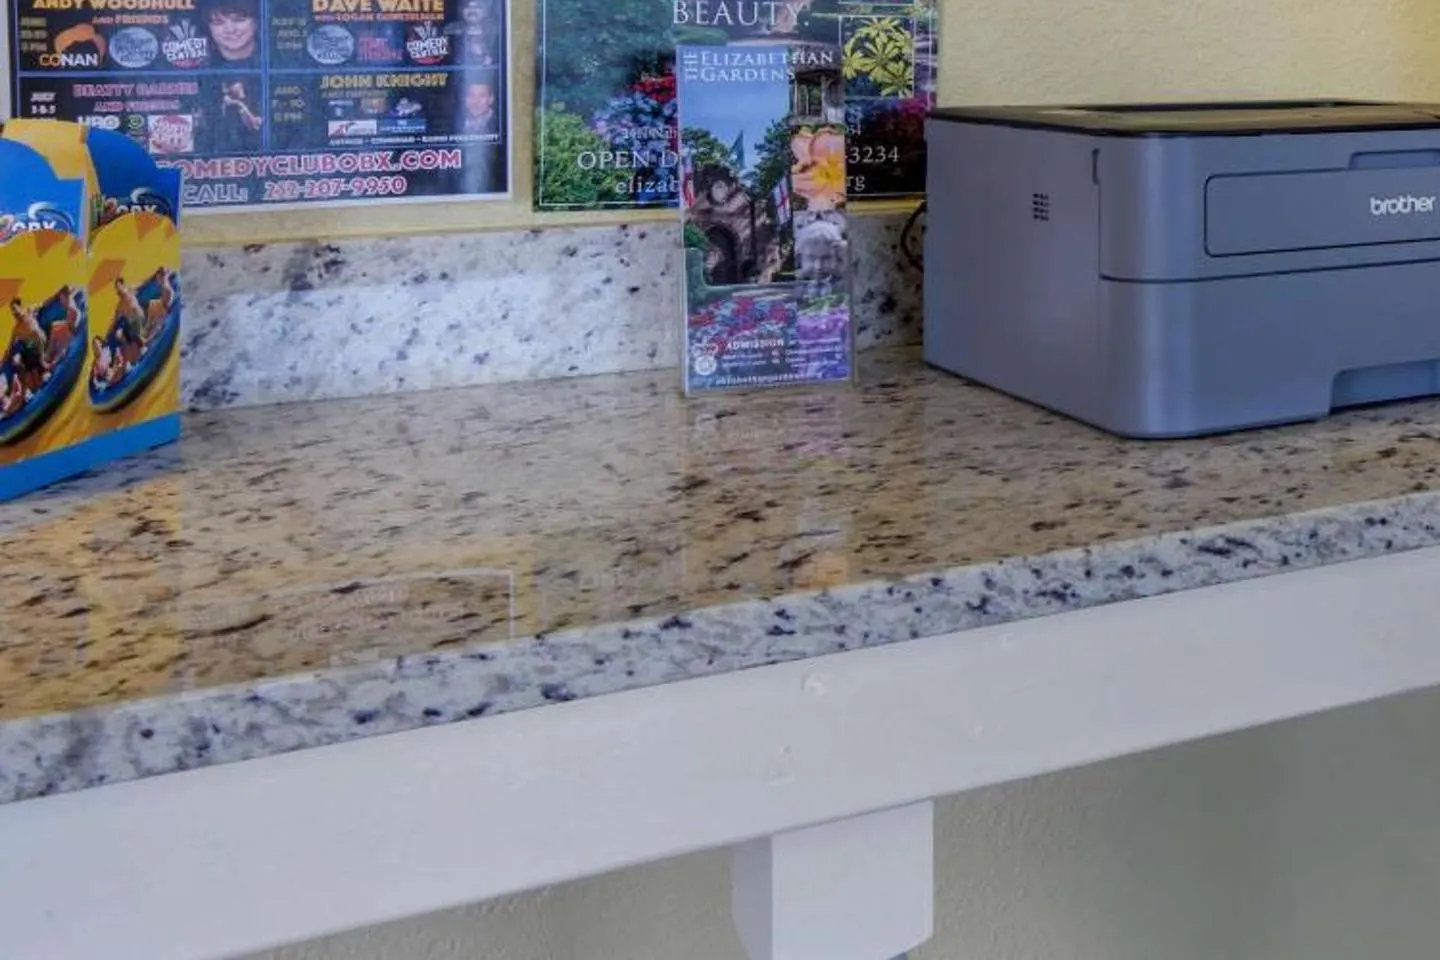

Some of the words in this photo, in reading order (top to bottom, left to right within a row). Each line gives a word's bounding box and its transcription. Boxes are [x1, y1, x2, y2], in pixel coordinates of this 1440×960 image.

[39, 53, 99, 67] CONAN
[701, 50, 834, 67] ELIZABETHAN
[320, 73, 373, 89] JOHN
[375, 73, 448, 88] KNIGHT
[699, 66, 796, 83] GARDENS
[577, 150, 651, 170] OPEN
[1370, 194, 1436, 216] brother
